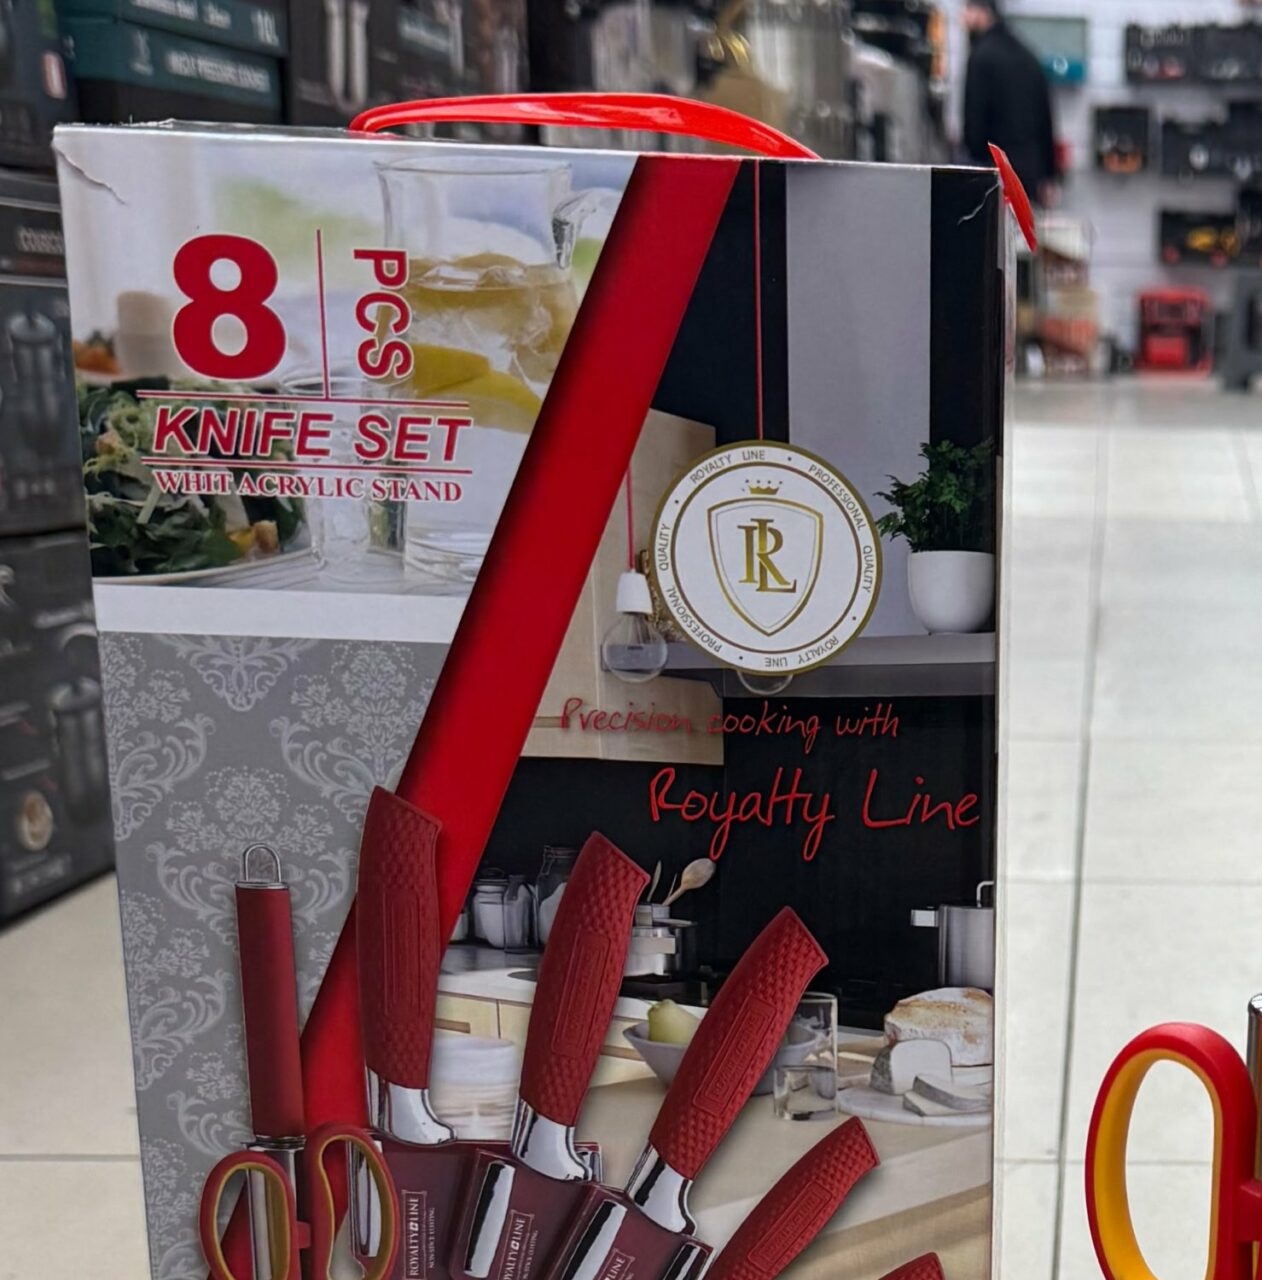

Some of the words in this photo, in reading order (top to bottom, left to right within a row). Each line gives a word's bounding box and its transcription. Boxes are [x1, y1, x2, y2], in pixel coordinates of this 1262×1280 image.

[172, 233, 286, 381] 8
[353, 248, 414, 380] PCS
[152, 406, 334, 458] KNIFE
[353, 413, 473, 463] SET
[152, 469, 233, 494] WHIT
[238, 473, 365, 499] ACRYLIC
[371, 477, 463, 502] STAND
[689, 453, 733, 484] ROYALTY
[742, 449, 766, 462] LINE
[657, 523, 672, 571] QUALITY
[808, 463, 867, 531] PROFESSIONAL
[862, 545, 877, 594] QUALITY
[666, 586, 723, 654] PROFESSIONAL
[797, 635, 840, 665] ROYALTY
[559, 697, 692, 736] Precision
[707, 700, 821, 756] cooking
[835, 702, 901, 739] with
[648, 766, 836, 862] Royalty
[861, 767, 981, 831] Line
[408, 1197, 420, 1222] LINE
[511, 1217, 526, 1240] LINE
[408, 1233, 420, 1276] ROYALTY
[607, 1256, 626, 1280] LINE
